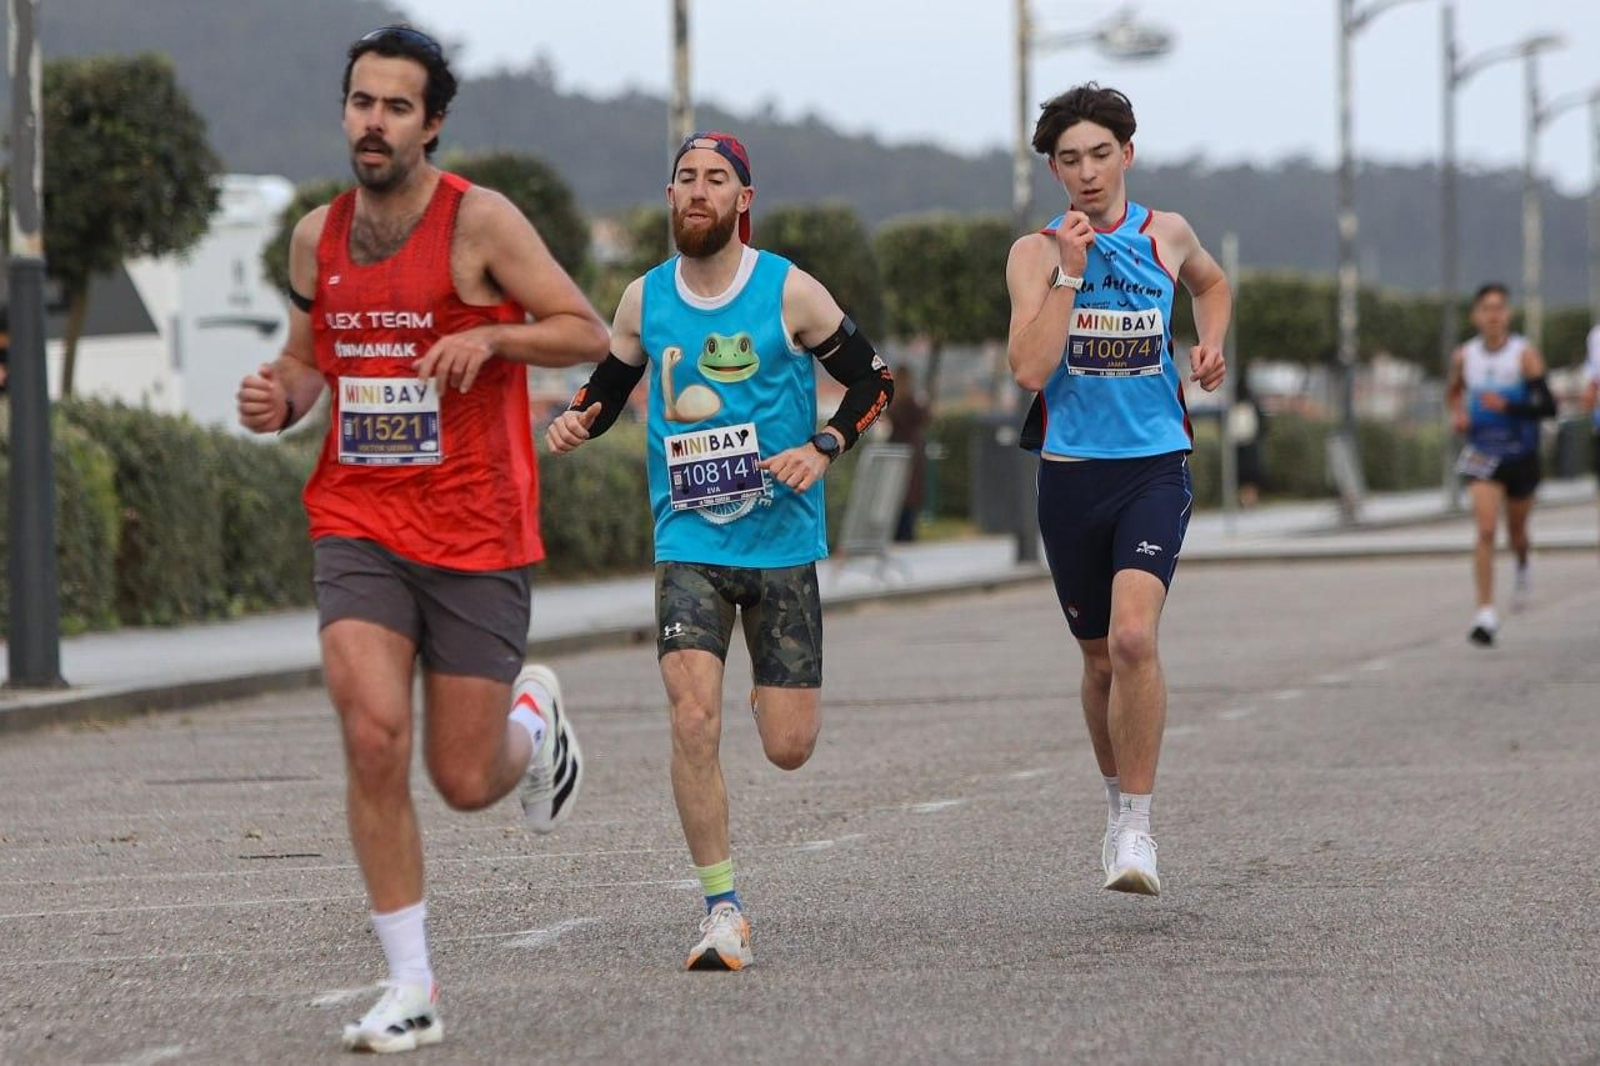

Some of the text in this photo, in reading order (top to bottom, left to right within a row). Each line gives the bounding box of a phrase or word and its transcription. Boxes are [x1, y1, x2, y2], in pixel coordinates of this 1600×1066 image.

[366, 310, 434, 329] TEAM
[1076, 313, 1156, 331] MINIBAY
[1085, 338, 1151, 358] 10074
[345, 385, 428, 405] MINIBAY
[353, 415, 422, 440] 11521
[670, 430, 748, 458] MINIBAY
[683, 457, 749, 487] 10814
[706, 486, 721, 495] EVA
